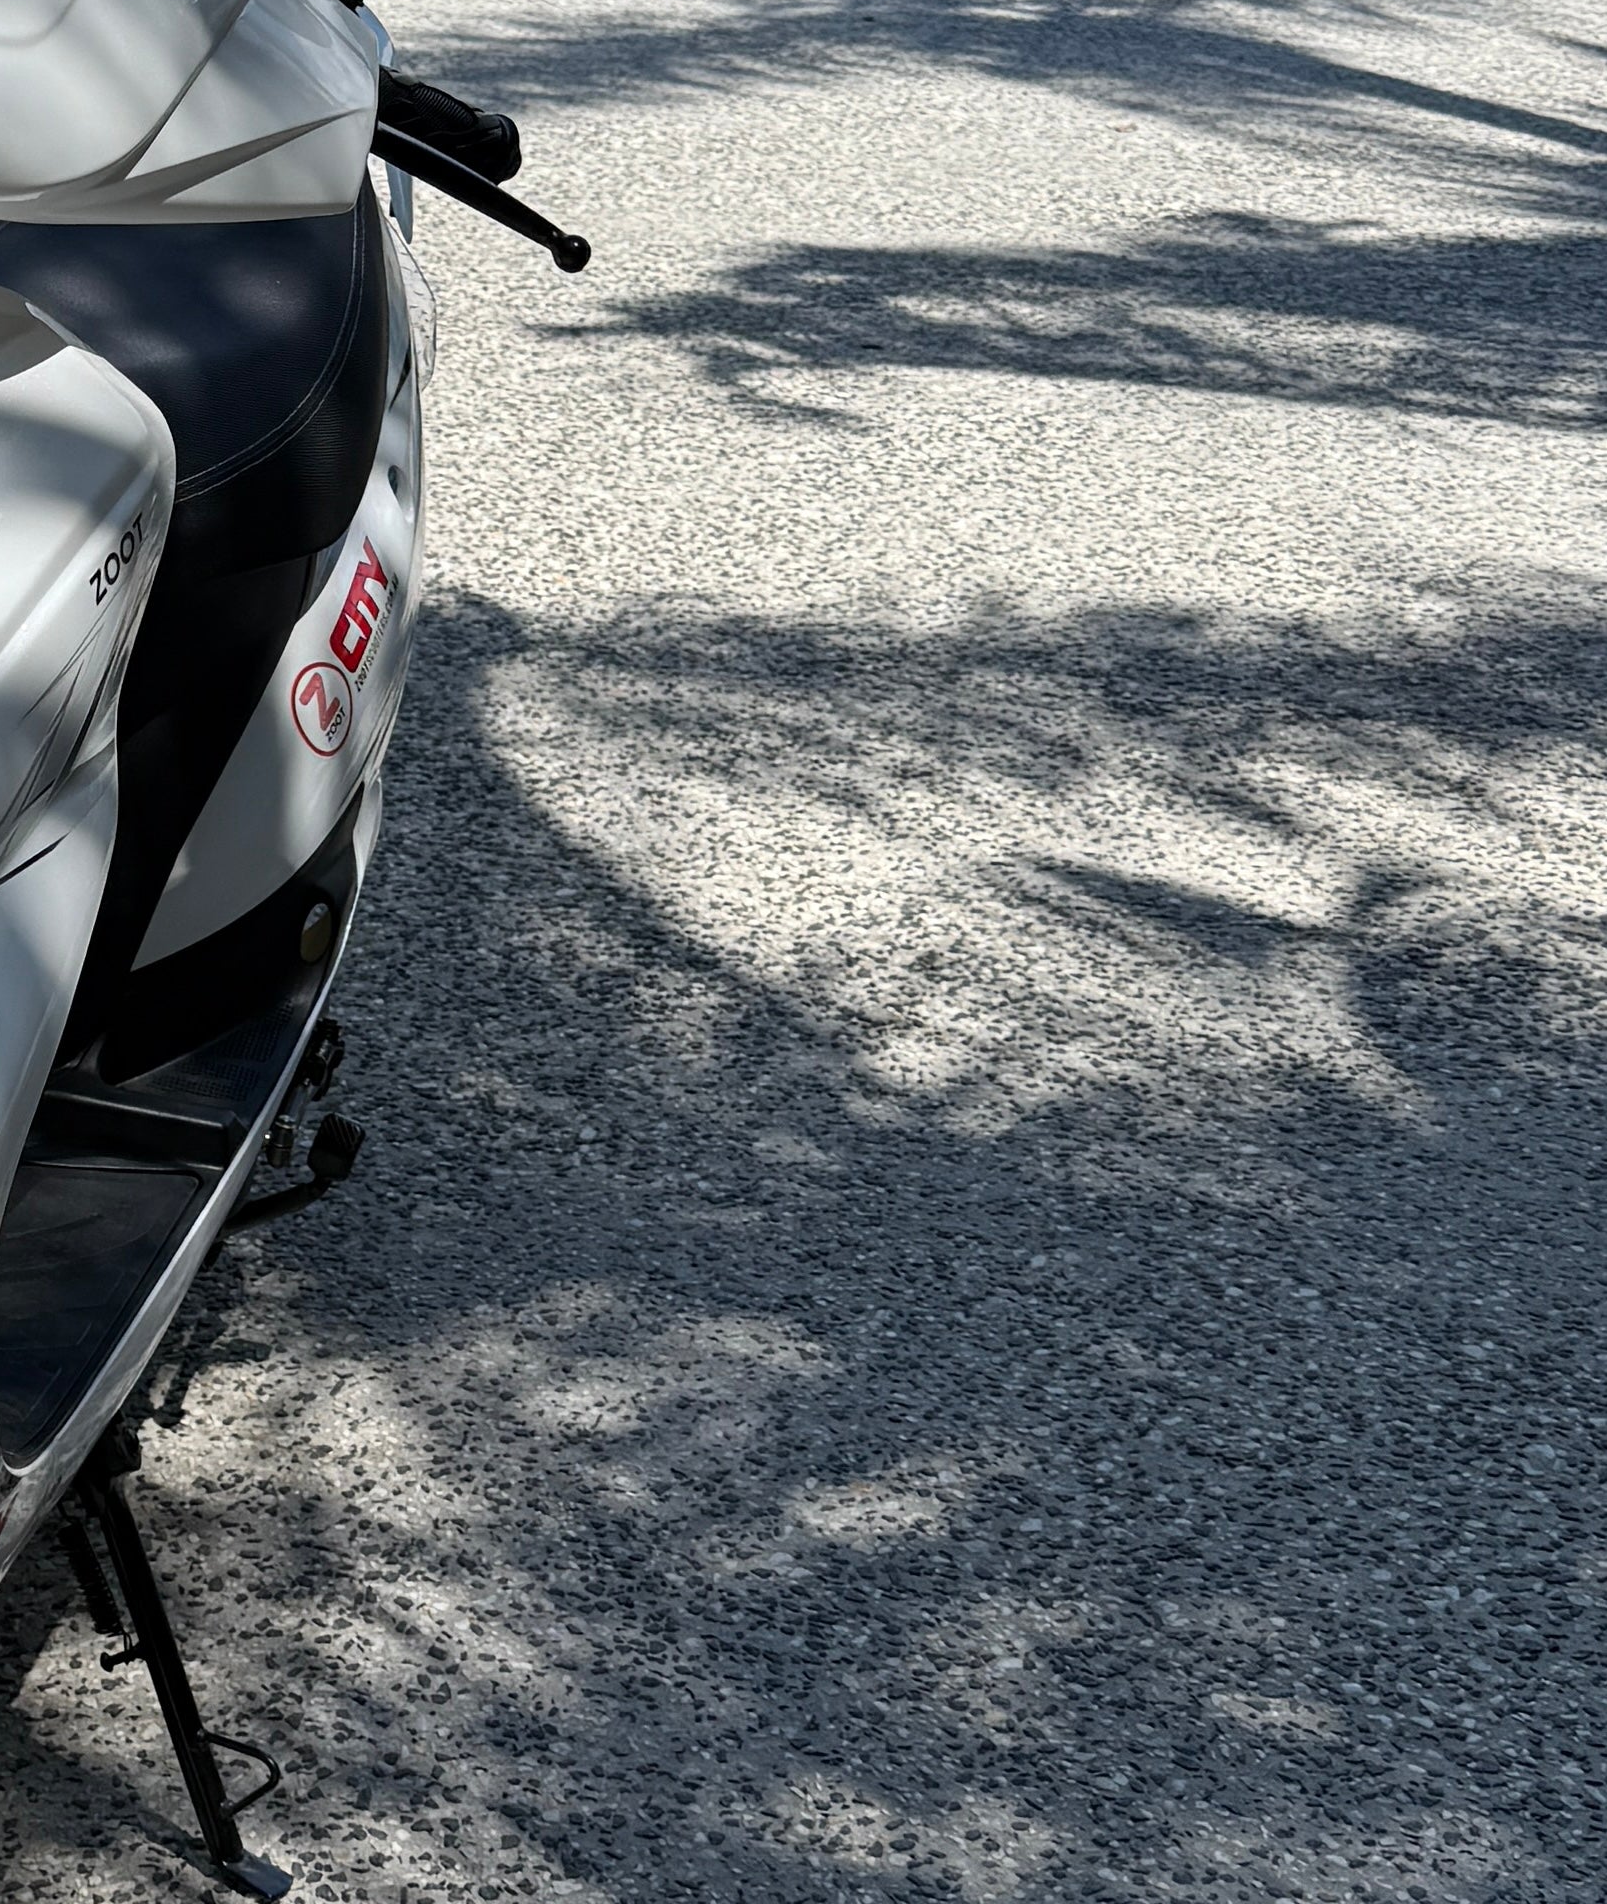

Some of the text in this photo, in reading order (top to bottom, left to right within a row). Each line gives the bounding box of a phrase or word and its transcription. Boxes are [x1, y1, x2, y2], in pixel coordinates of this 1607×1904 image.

[90, 513, 145, 606] ZOOT
[330, 536, 389, 674] CITY
[300, 672, 339, 731] Z
[325, 707, 347, 742] ZOOT
